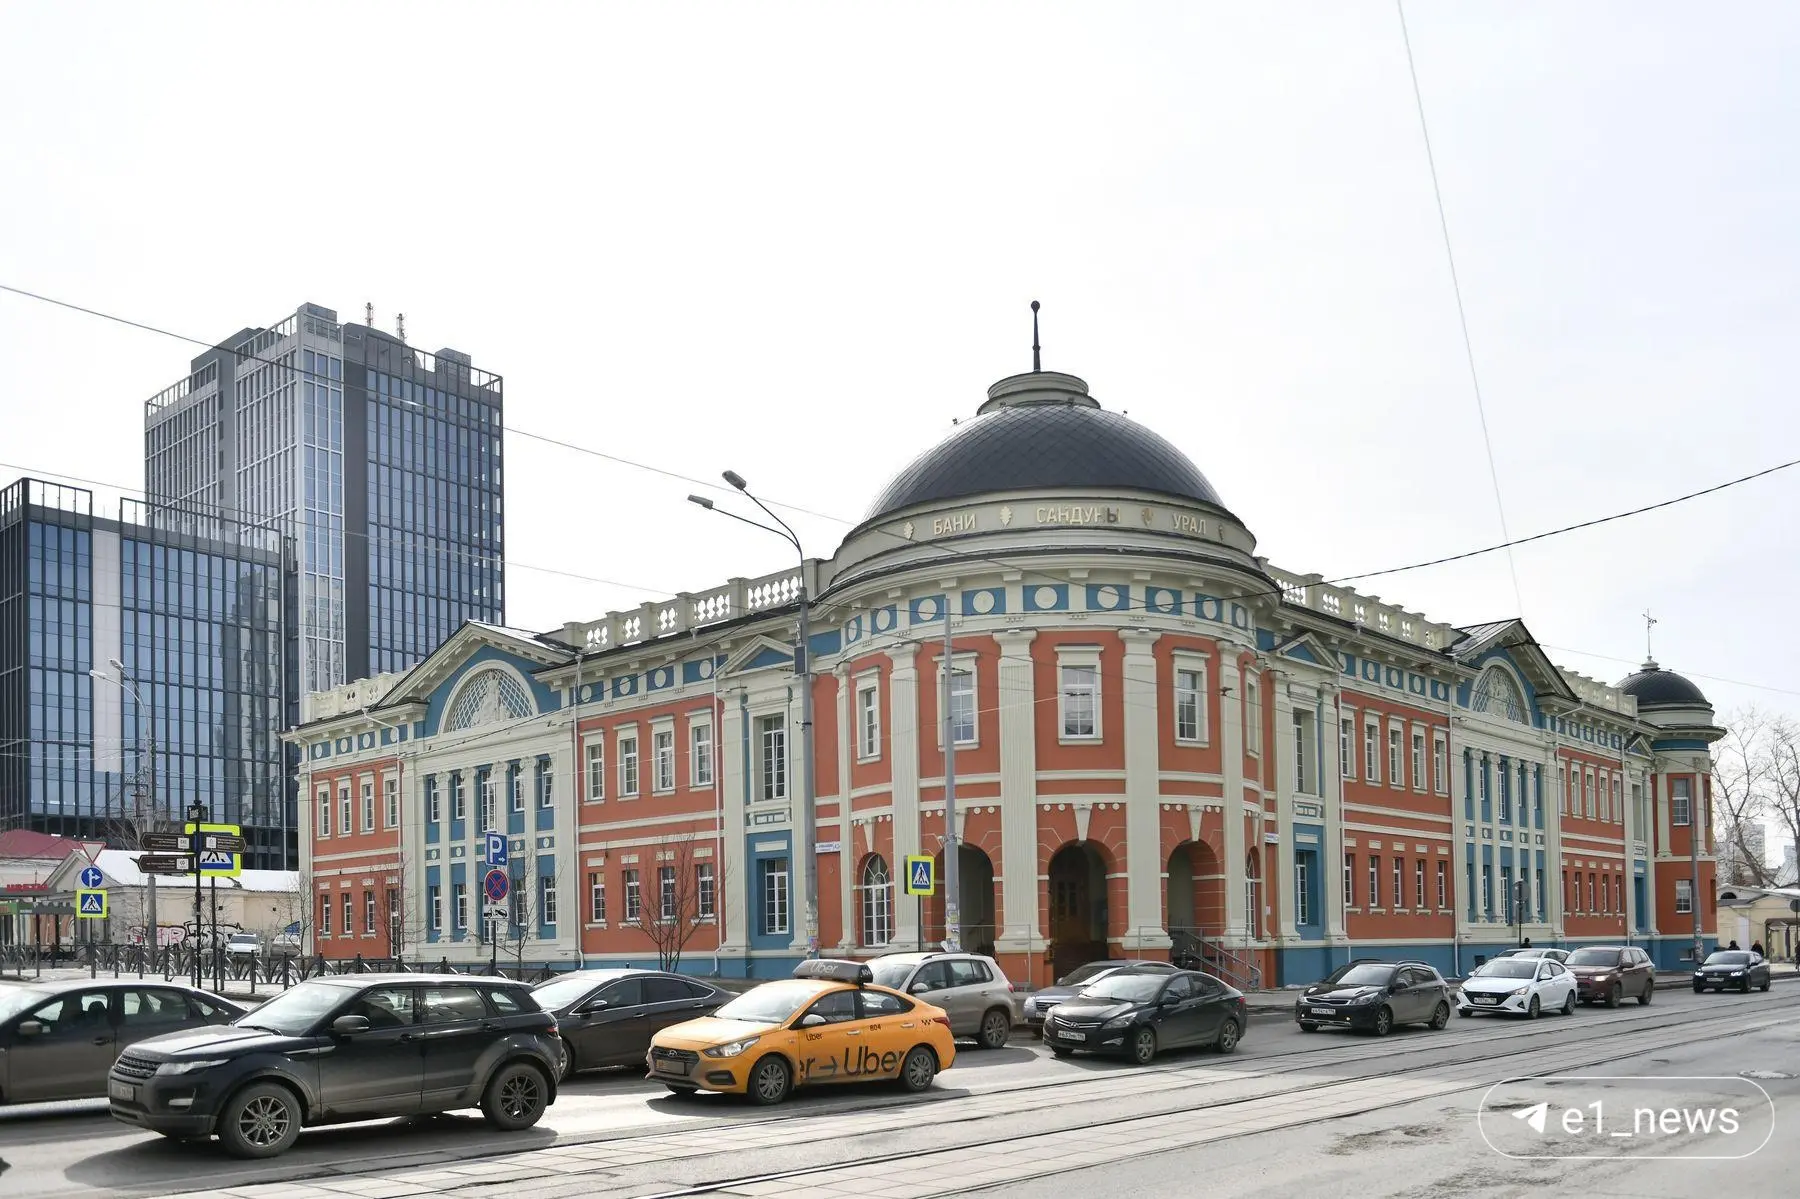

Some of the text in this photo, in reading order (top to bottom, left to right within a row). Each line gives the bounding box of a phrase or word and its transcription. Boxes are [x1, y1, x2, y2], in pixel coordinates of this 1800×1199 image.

[933, 506, 1206, 535] БАНИ САНДУНЫ УРАЛ
[809, 962, 838, 975] Uber
[869, 1023, 882, 1032] 804
[805, 1032, 823, 1041] Uber
[843, 1045, 906, 1077] Uber
